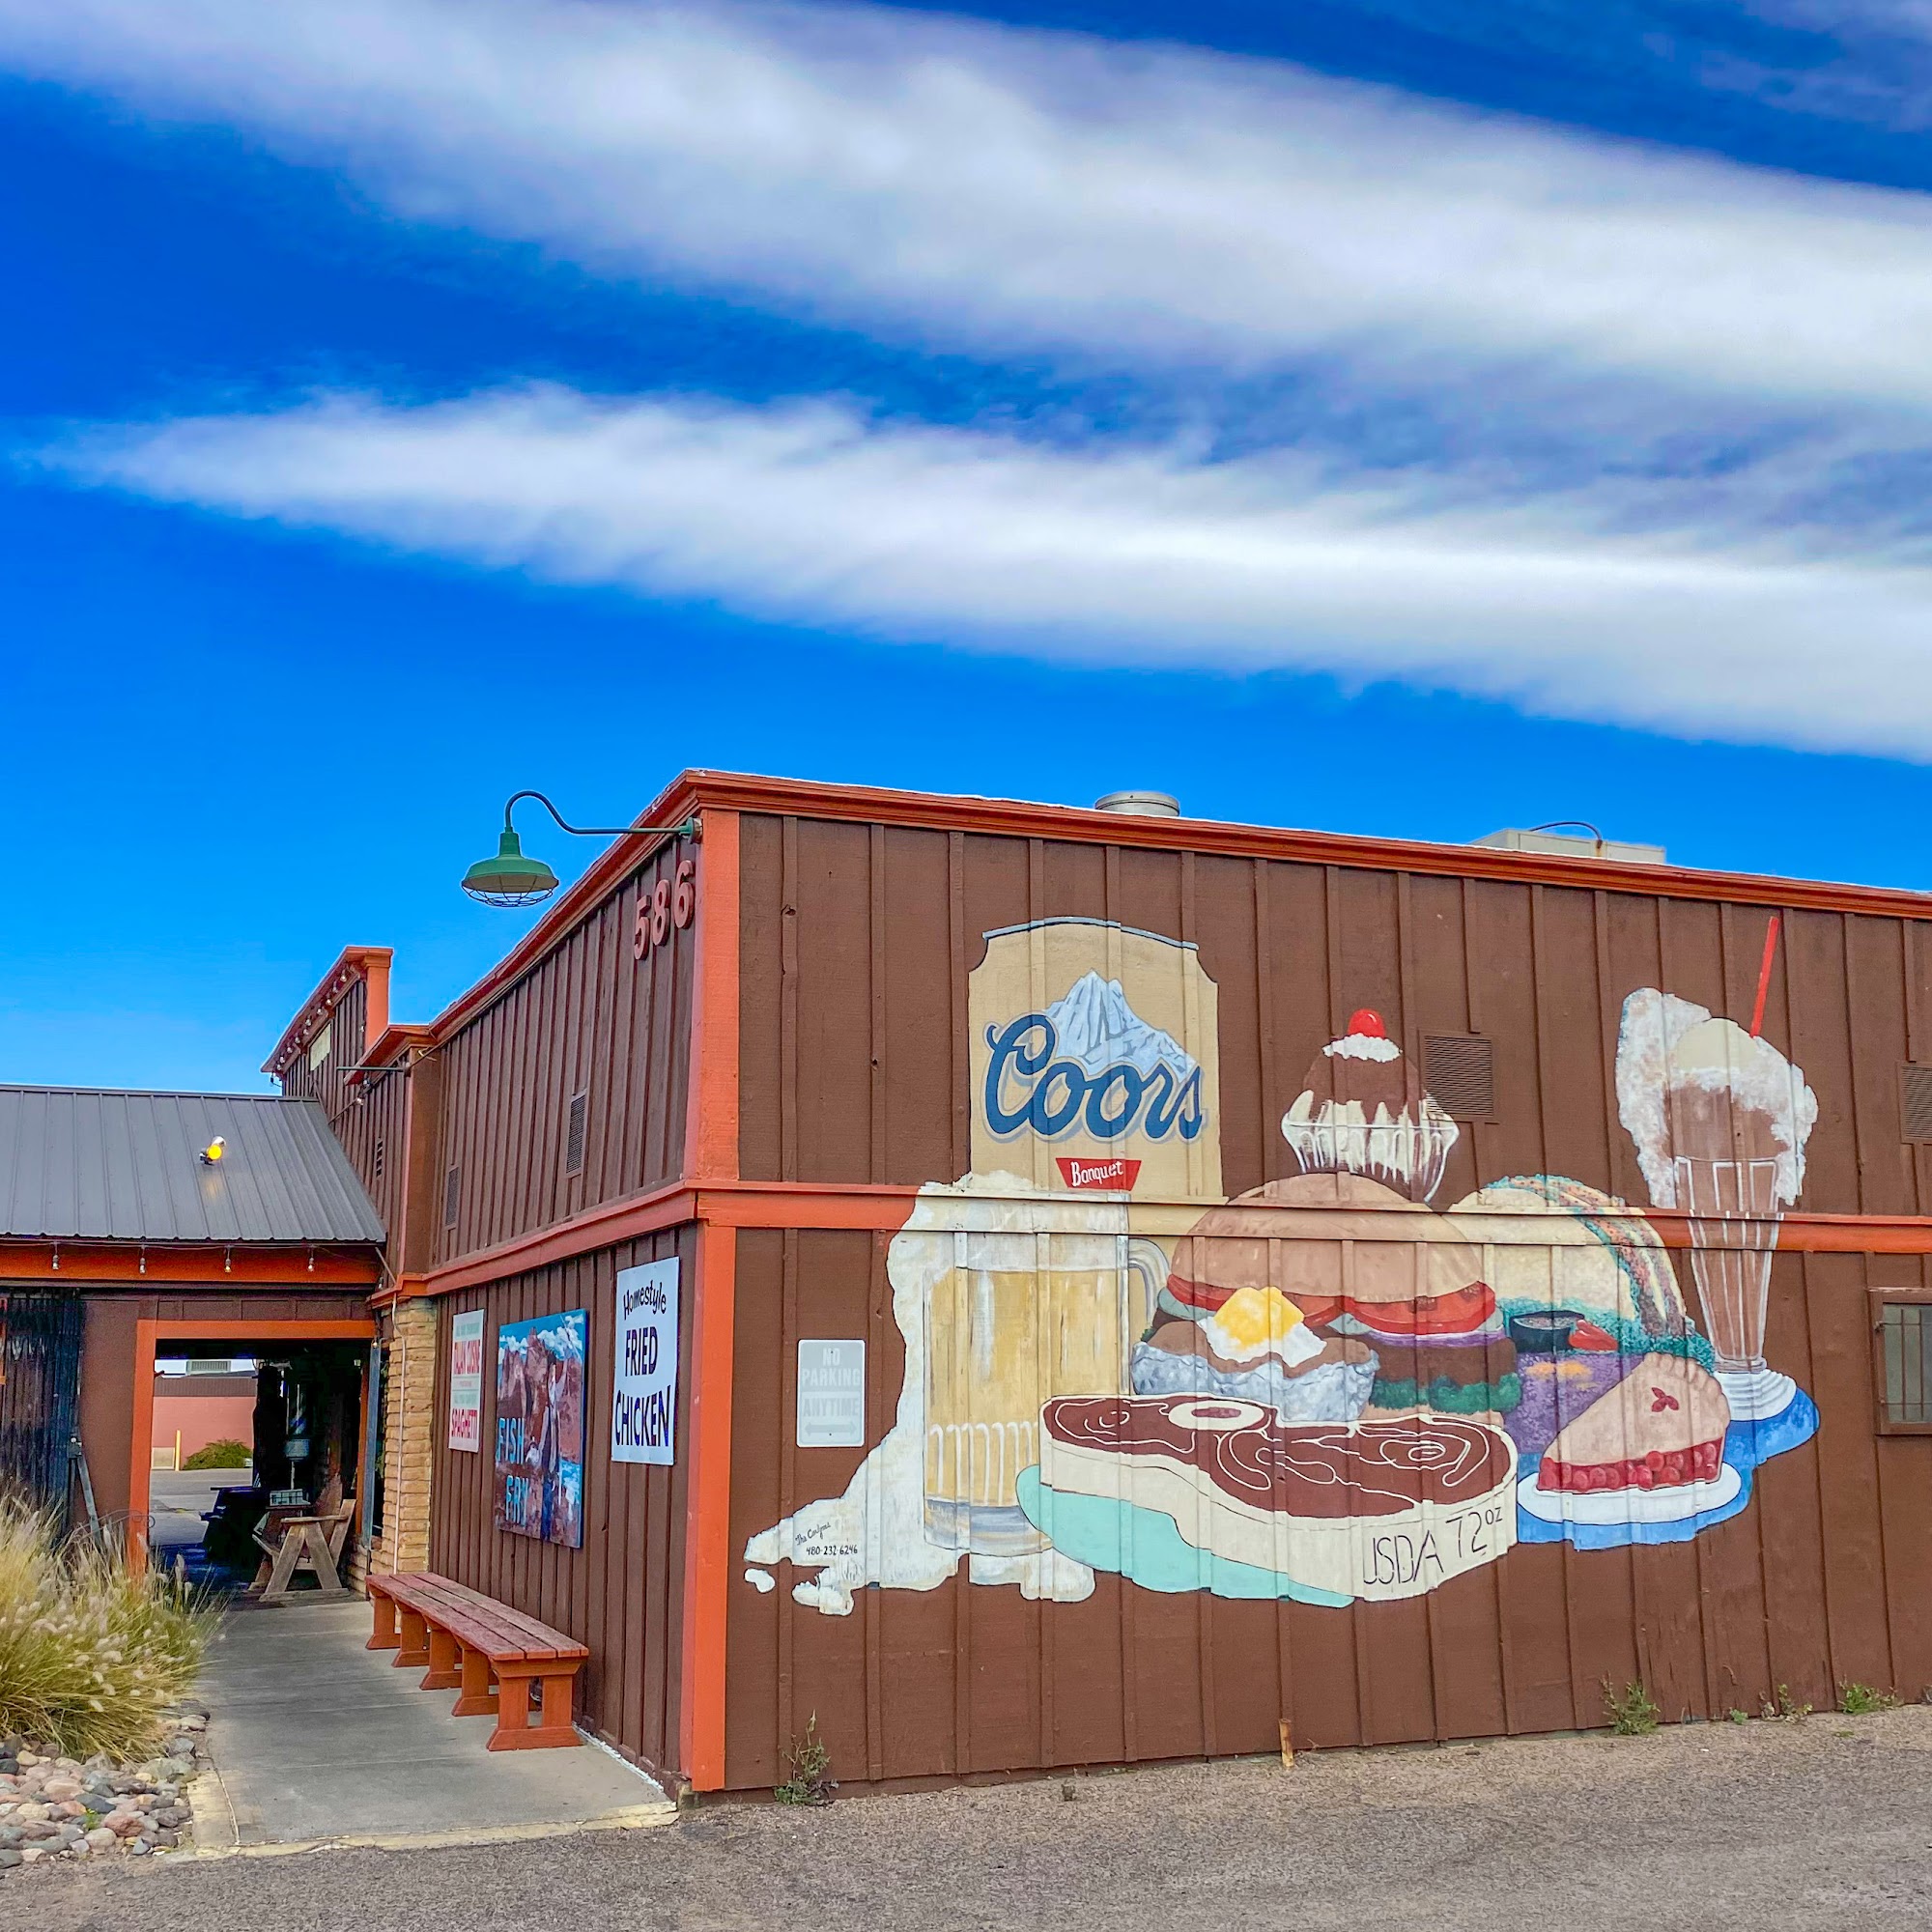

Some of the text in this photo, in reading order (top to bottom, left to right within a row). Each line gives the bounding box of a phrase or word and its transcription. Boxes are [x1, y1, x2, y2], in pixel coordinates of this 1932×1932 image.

[634, 859, 695, 960] 586
[982, 1012, 1206, 1142] Coors
[1069, 1160, 1123, 1187] Banquet
[623, 1279, 668, 1321] Homestyle
[624, 1325, 659, 1378] FRIED
[822, 1347, 841, 1367] NO
[801, 1367, 862, 1387] PARKING
[451, 1407, 478, 1440] SPAGHETTI
[614, 1384, 671, 1447] CHICKEN
[802, 1397, 861, 1418] ANYTIME
[496, 1416, 526, 1465] FISH
[505, 1474, 530, 1527] FRY
